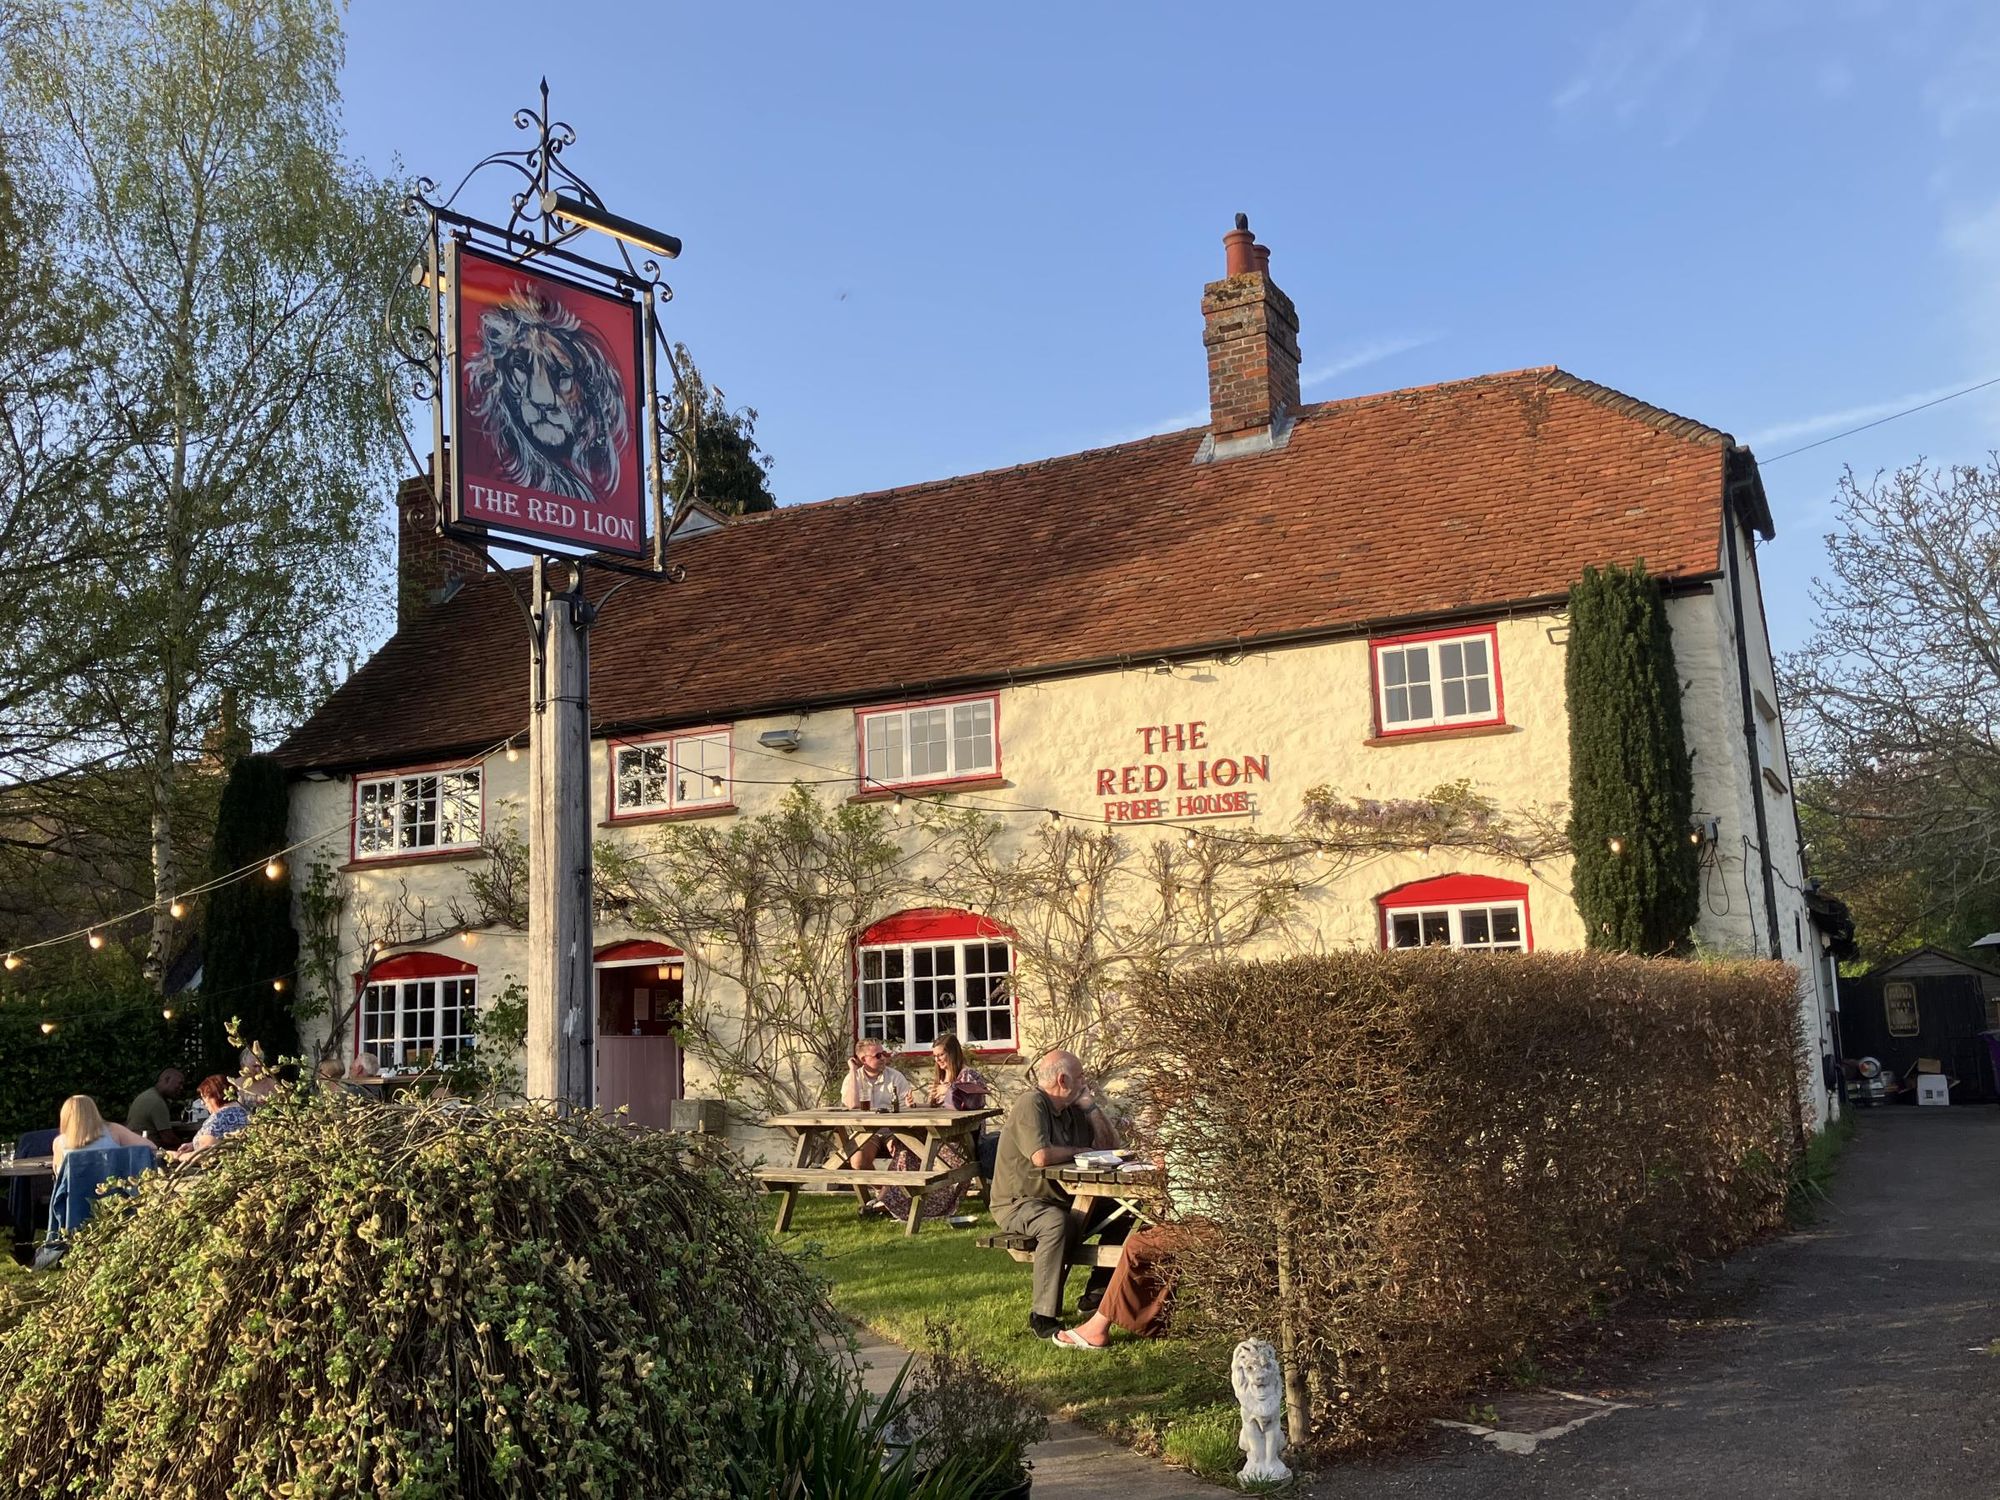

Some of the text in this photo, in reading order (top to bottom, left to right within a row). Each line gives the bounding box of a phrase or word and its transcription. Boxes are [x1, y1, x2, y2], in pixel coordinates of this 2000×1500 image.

[468, 484, 634, 541] THE RED LION
[1136, 721, 1208, 755] THE
[1096, 754, 1267, 796] RED LION
[1104, 790, 1249, 823] FREE HOUSE
